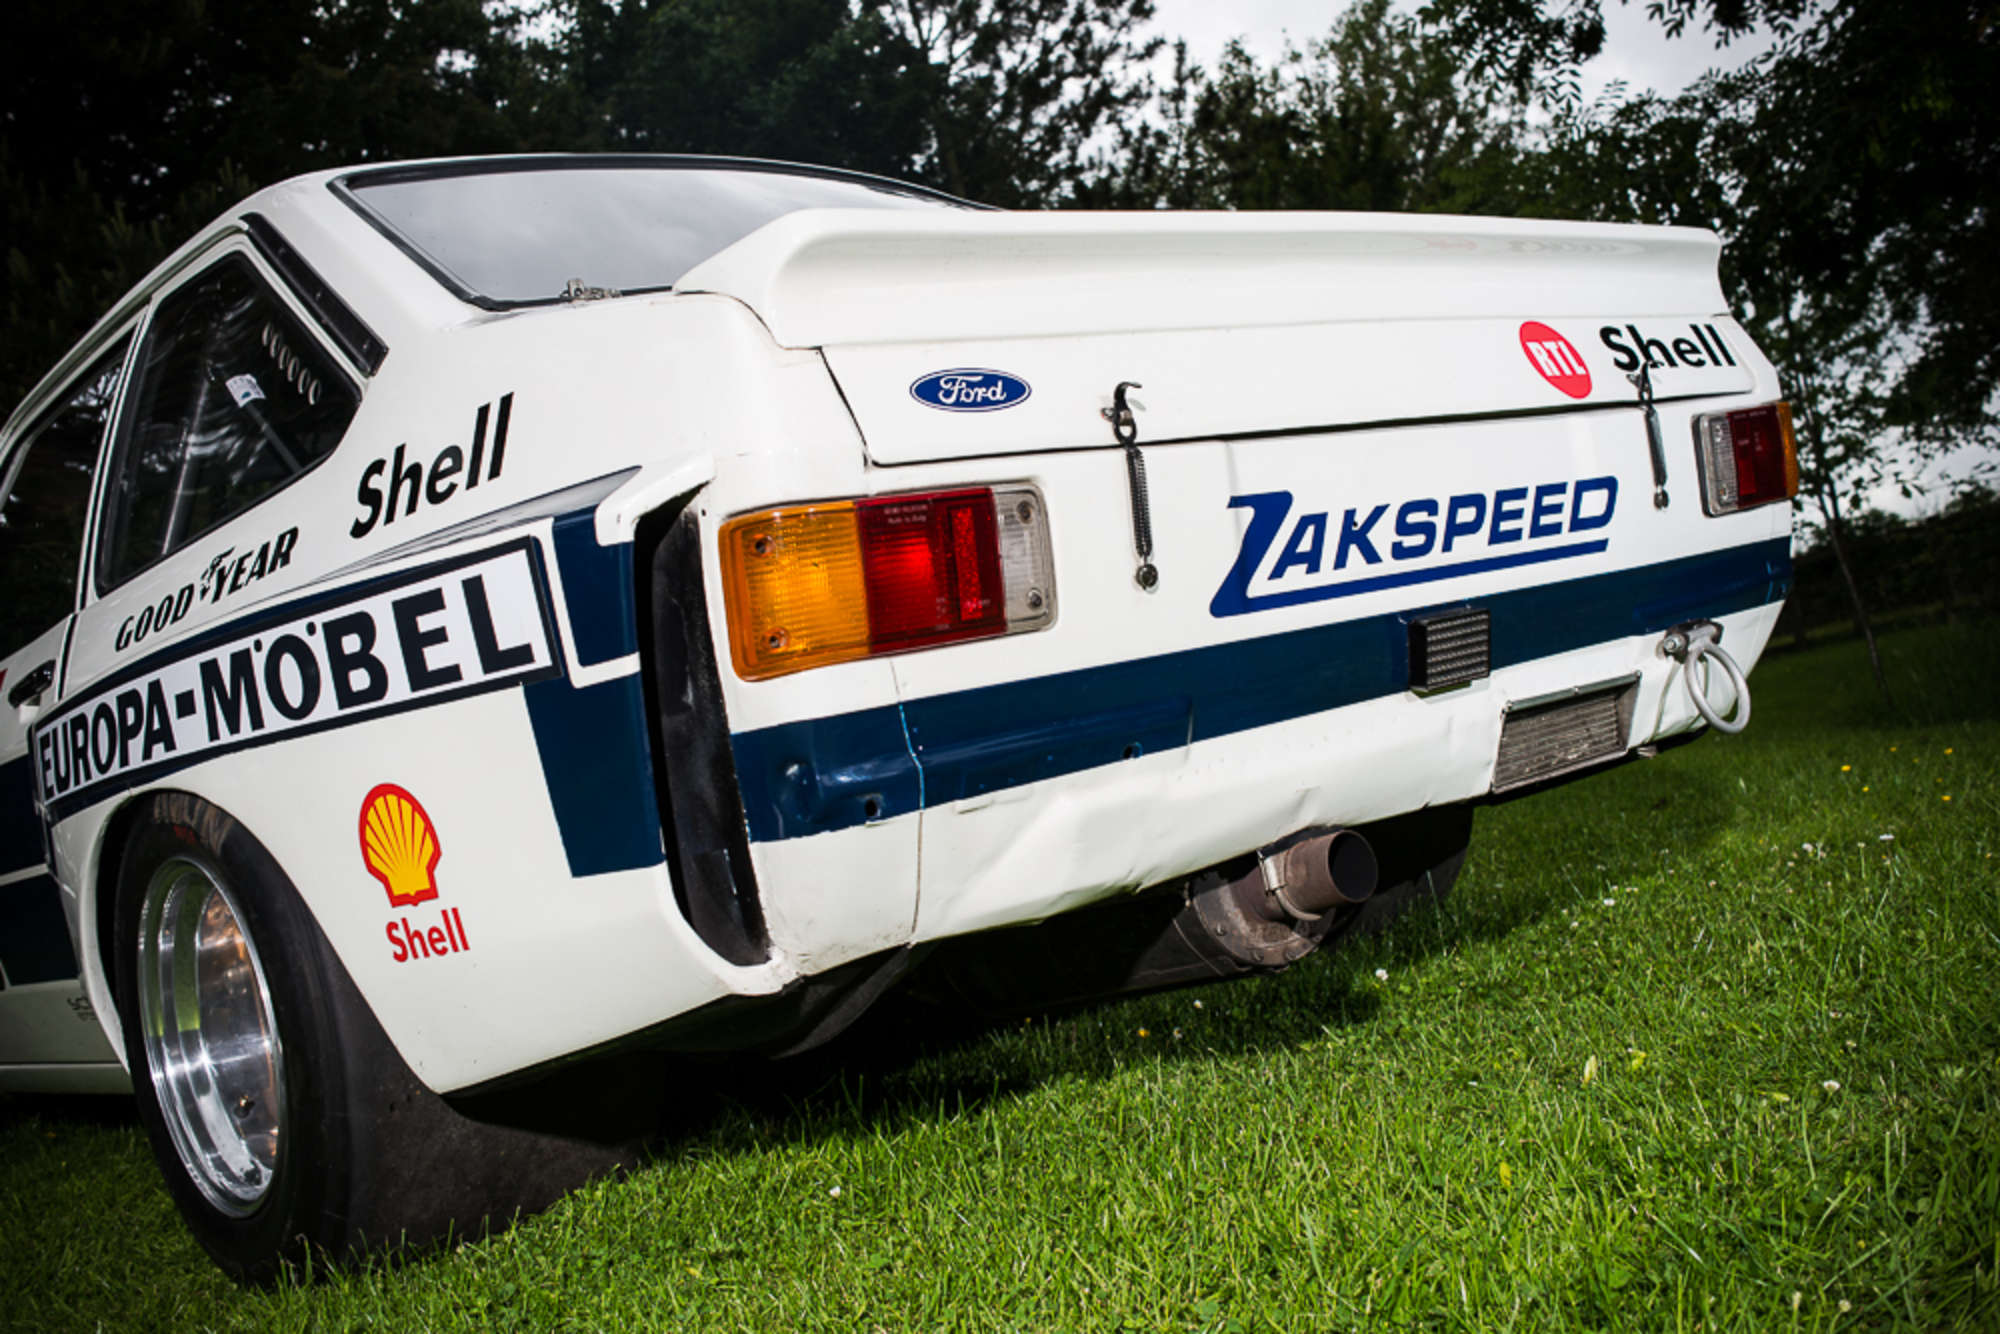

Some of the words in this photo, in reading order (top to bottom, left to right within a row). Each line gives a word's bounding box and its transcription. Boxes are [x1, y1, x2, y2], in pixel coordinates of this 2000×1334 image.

[1525, 340, 1586, 377] RTL
[1600, 324, 1737, 371] Shell
[938, 375, 1007, 404] Ford
[350, 391, 514, 539] Shell
[1209, 475, 1618, 618] ZAKSPEED
[38, 574, 535, 801] EUROPA-MÖBEL
[386, 907, 470, 963] Shell
